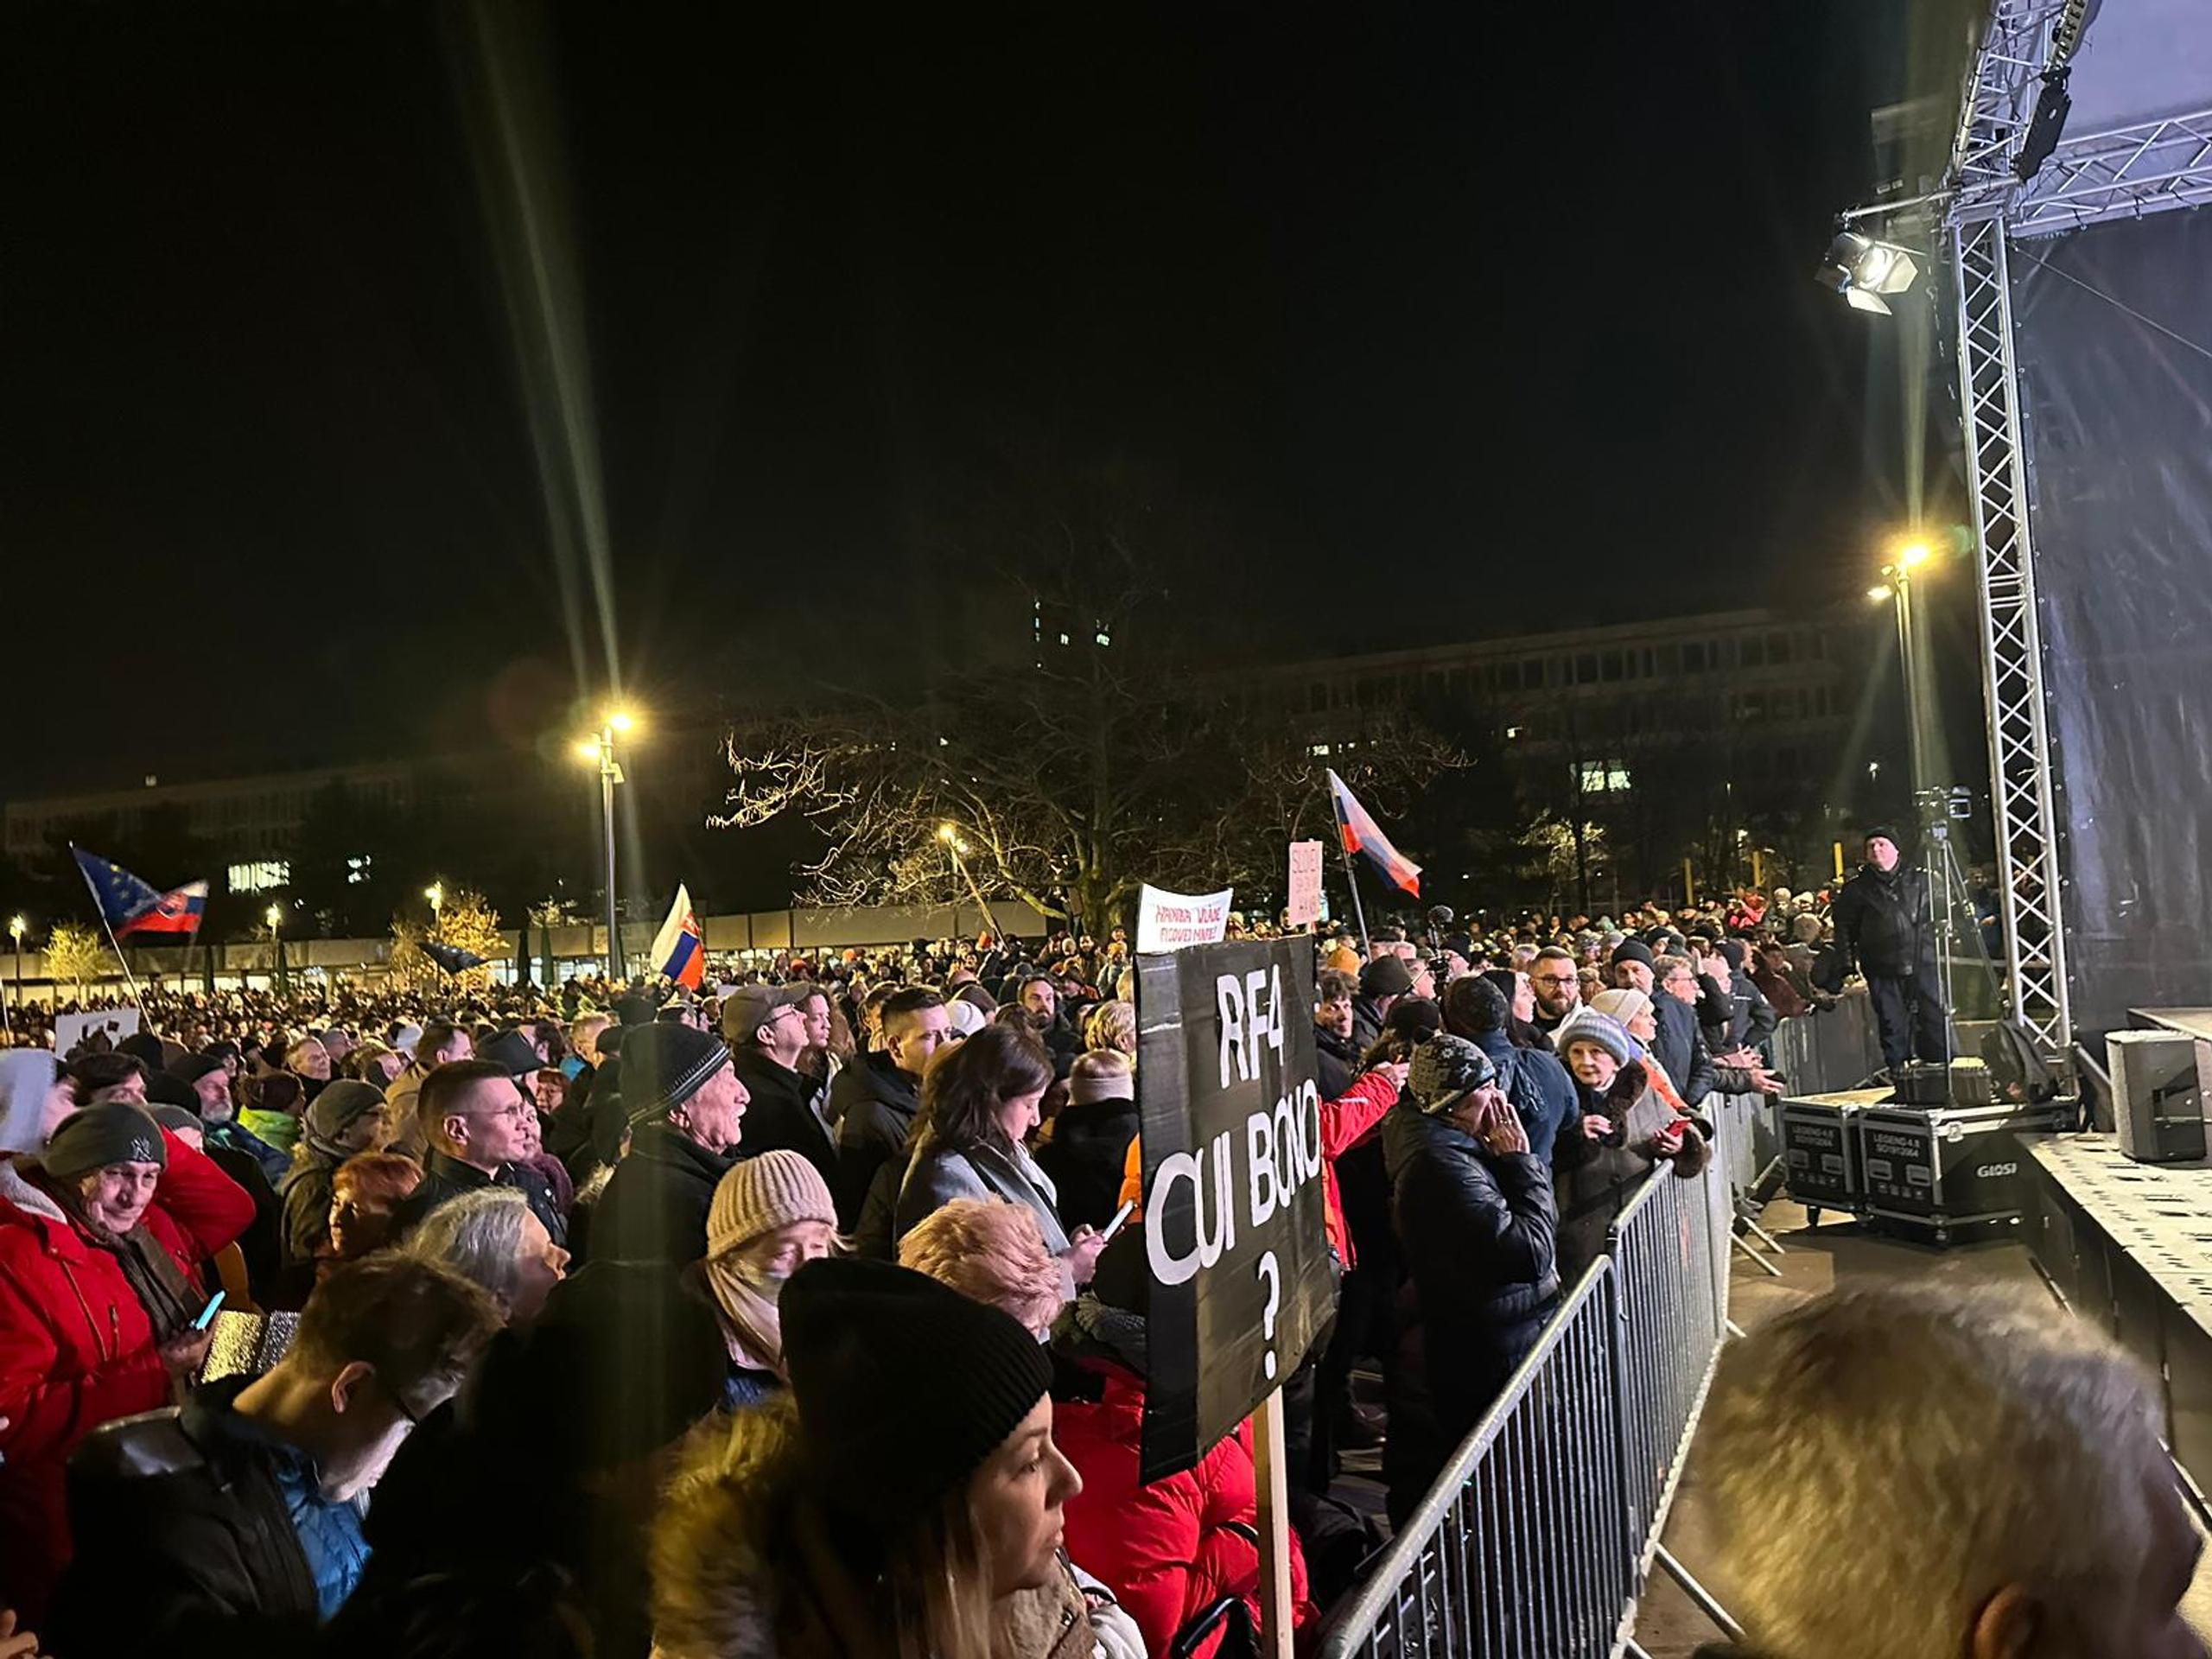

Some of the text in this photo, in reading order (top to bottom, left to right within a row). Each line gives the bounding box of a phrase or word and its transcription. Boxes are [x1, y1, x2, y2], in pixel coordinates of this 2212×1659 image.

[1217, 963, 1285, 1089] RF4
[1145, 1078, 1321, 1286] CUI BONO
[1257, 1250, 1281, 1381] ?
